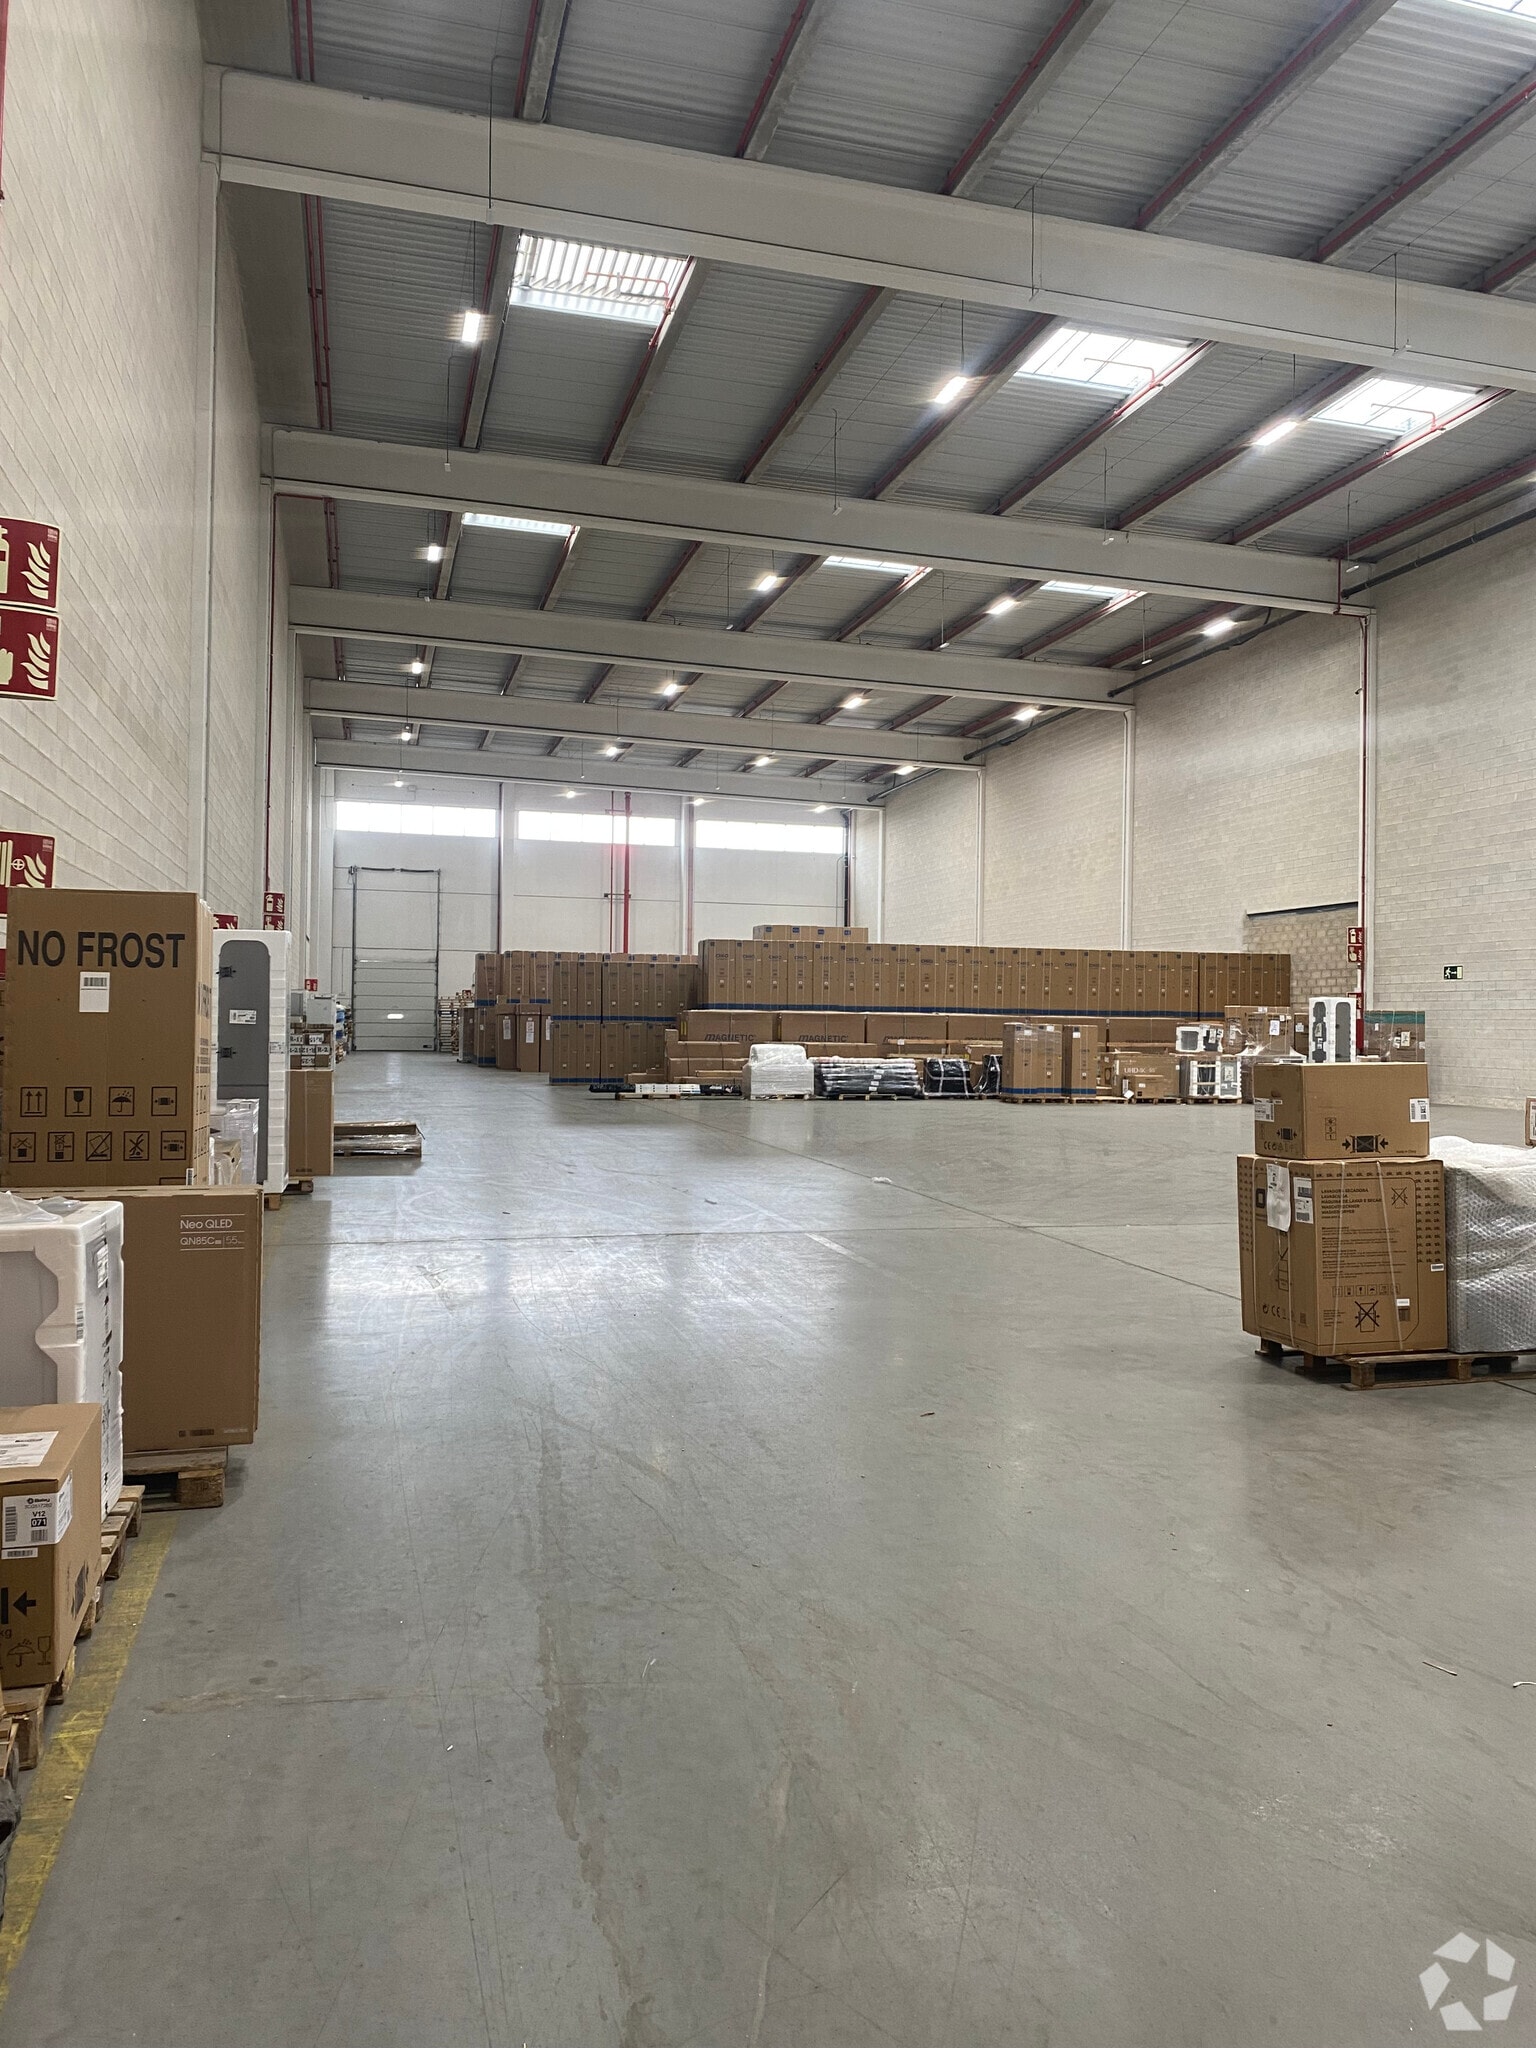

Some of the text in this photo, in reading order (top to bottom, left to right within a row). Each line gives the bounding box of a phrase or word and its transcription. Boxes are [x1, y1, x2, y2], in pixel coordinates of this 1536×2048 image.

[18, 930, 186, 968] NO FROST
[180, 1218, 233, 1229] Neo QLED
[180, 1236, 215, 1246] QN85C
[31, 1518, 47, 1527] 071
